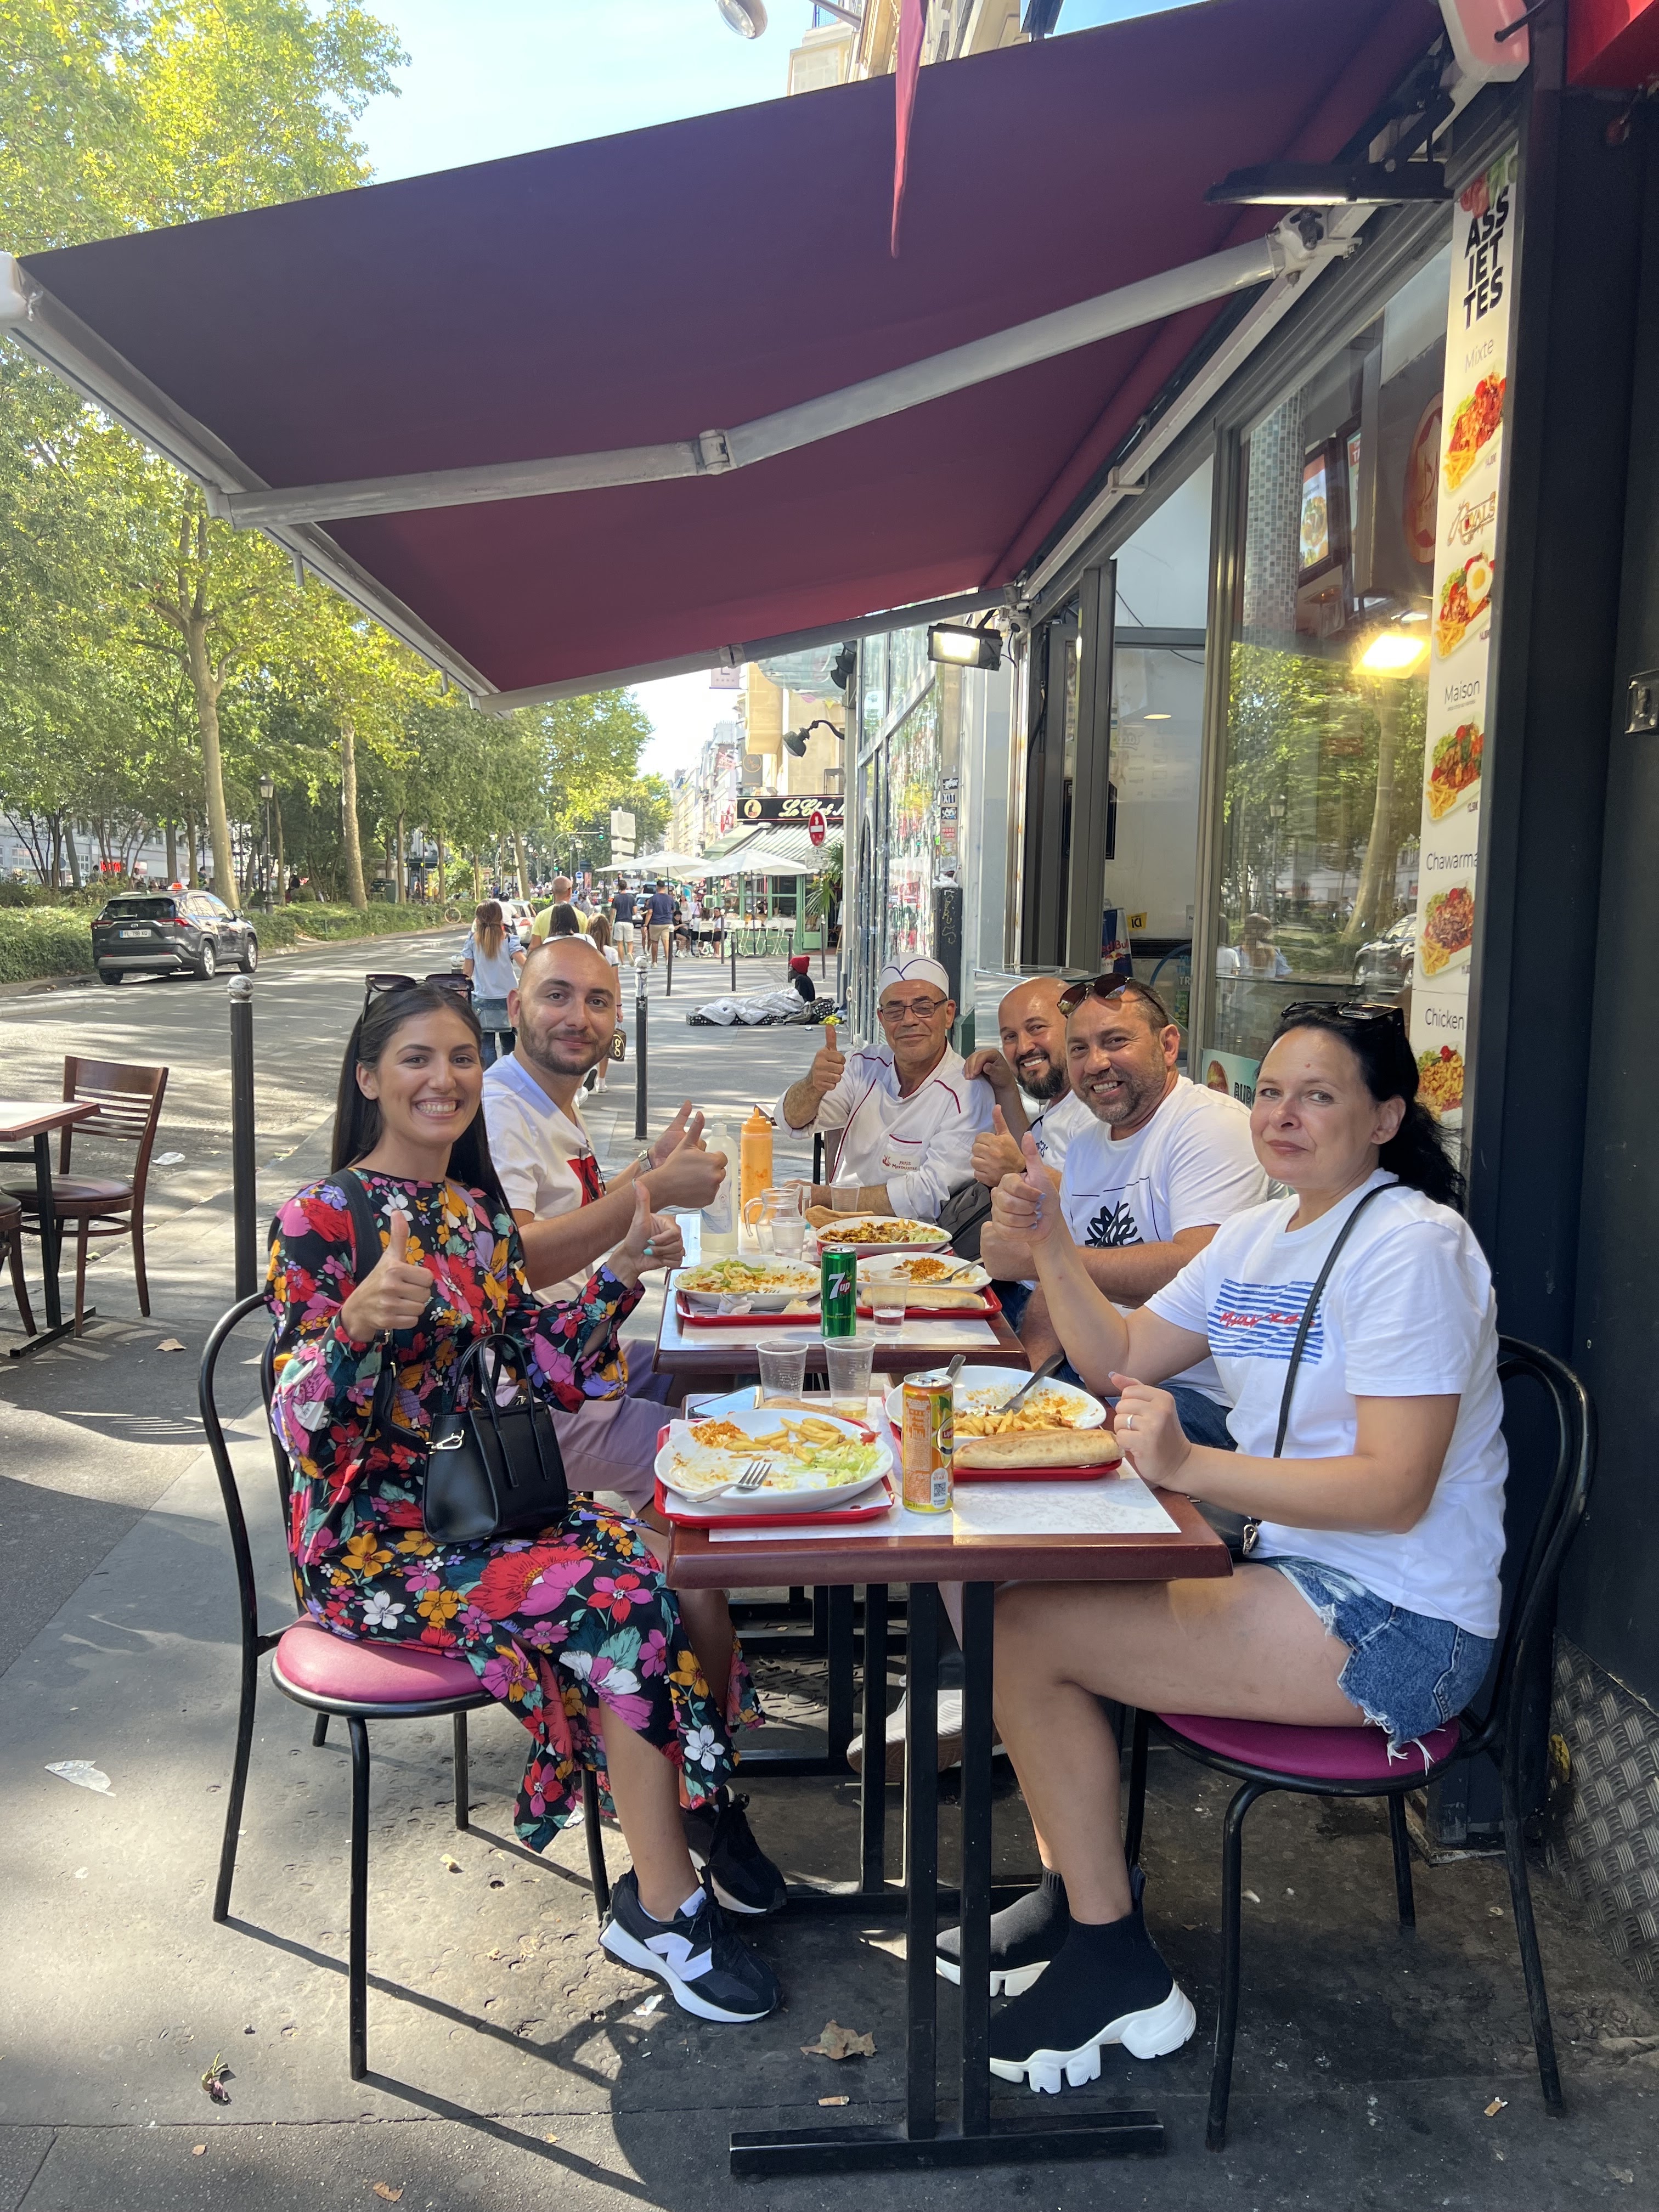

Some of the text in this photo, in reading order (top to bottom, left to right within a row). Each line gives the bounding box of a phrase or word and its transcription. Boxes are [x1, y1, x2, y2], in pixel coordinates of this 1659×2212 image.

[1464, 184, 1509, 259] ASS
[1468, 227, 1504, 292] IET
[1463, 266, 1504, 330] TES
[1465, 339, 1493, 374] Mixte
[1444, 680, 1480, 704] Maison
[1426, 851, 1478, 871] Chawarma
[1114, 939, 1129, 950] Bull
[1425, 1008, 1464, 1030] Chicken
